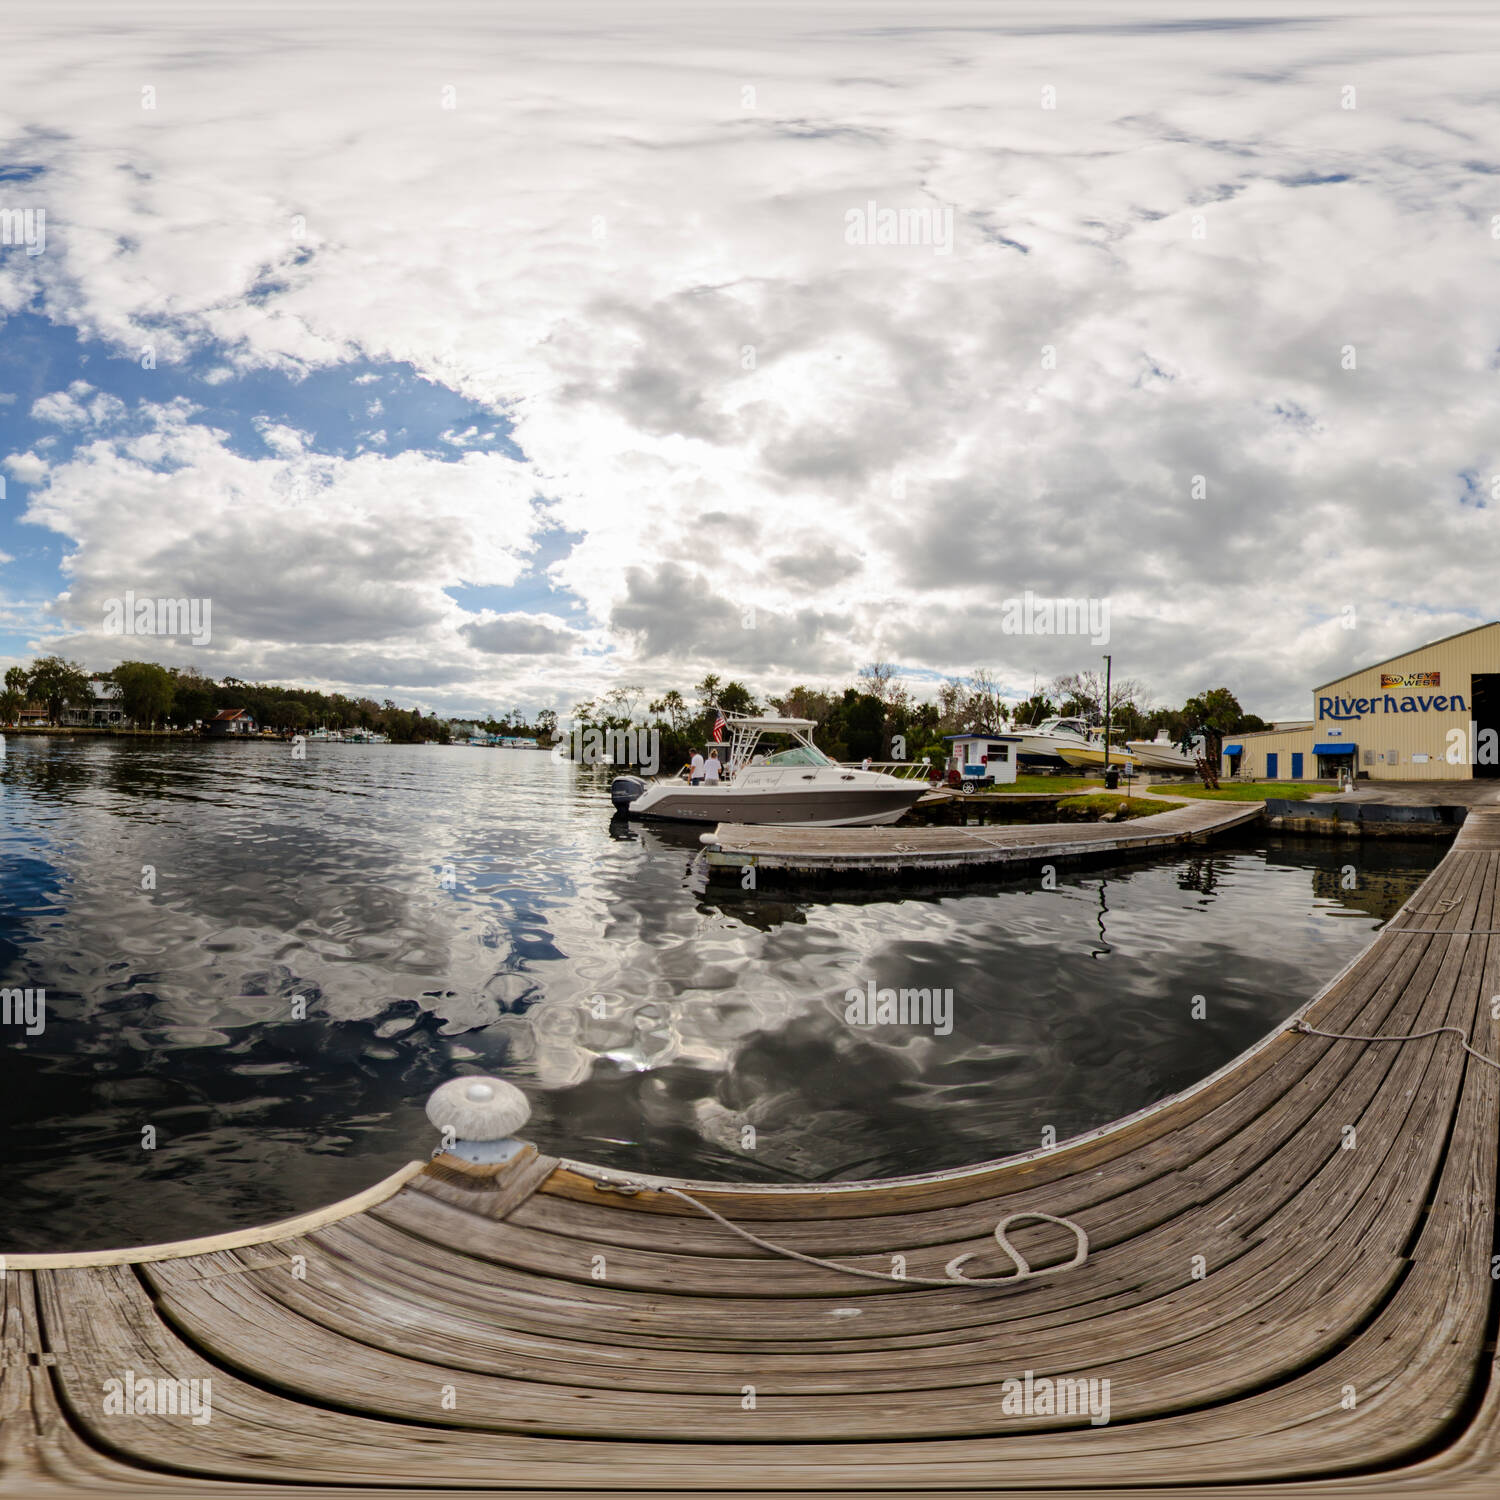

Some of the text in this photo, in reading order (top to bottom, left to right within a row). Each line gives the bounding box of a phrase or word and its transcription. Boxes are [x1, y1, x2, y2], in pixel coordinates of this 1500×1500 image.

[1409, 672, 1433, 680] KEY
[1404, 679, 1437, 687] WEST
[1319, 694, 1466, 720] Riverhaven
